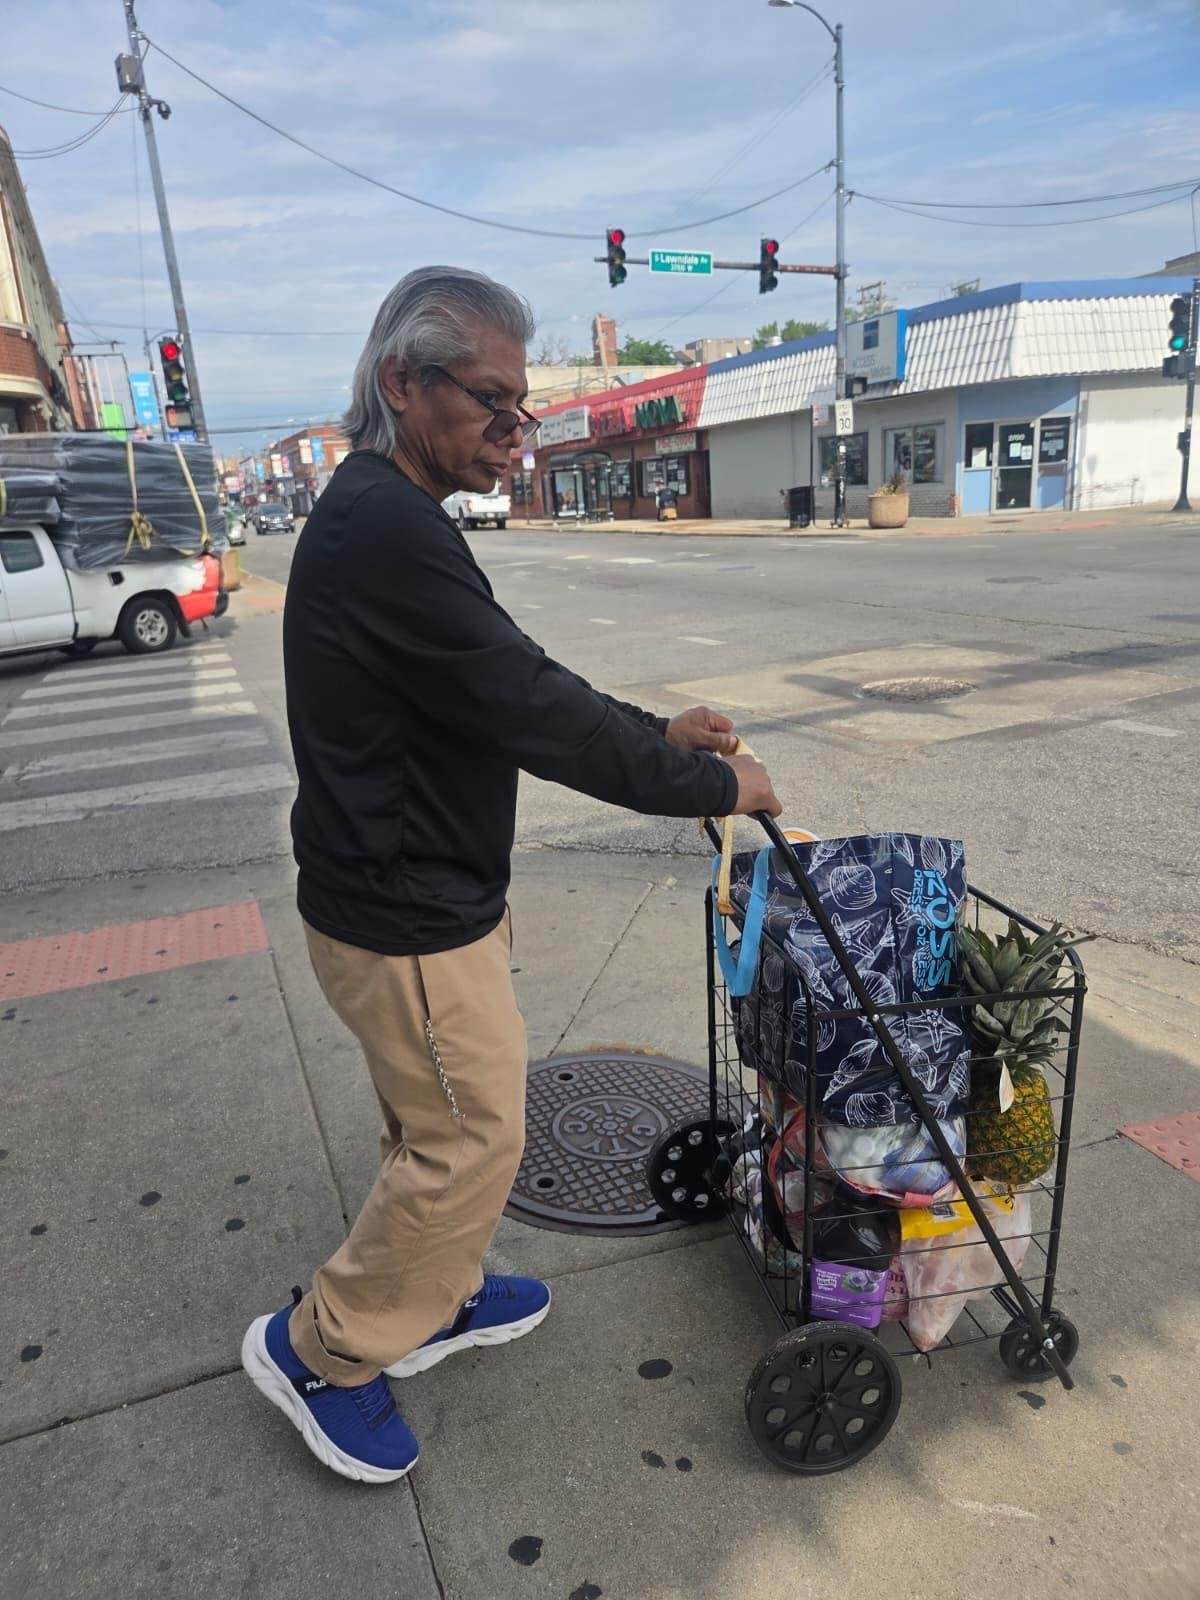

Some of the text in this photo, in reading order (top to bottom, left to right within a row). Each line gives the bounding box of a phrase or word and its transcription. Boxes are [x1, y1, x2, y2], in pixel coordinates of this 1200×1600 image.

[660, 253, 699, 265] Lawndale
[839, 417, 851, 430] 30
[911, 869, 927, 987] DRESS FOR LESS
[923, 870, 955, 986] ROSS
[581, 1123, 657, 1154] CITY
